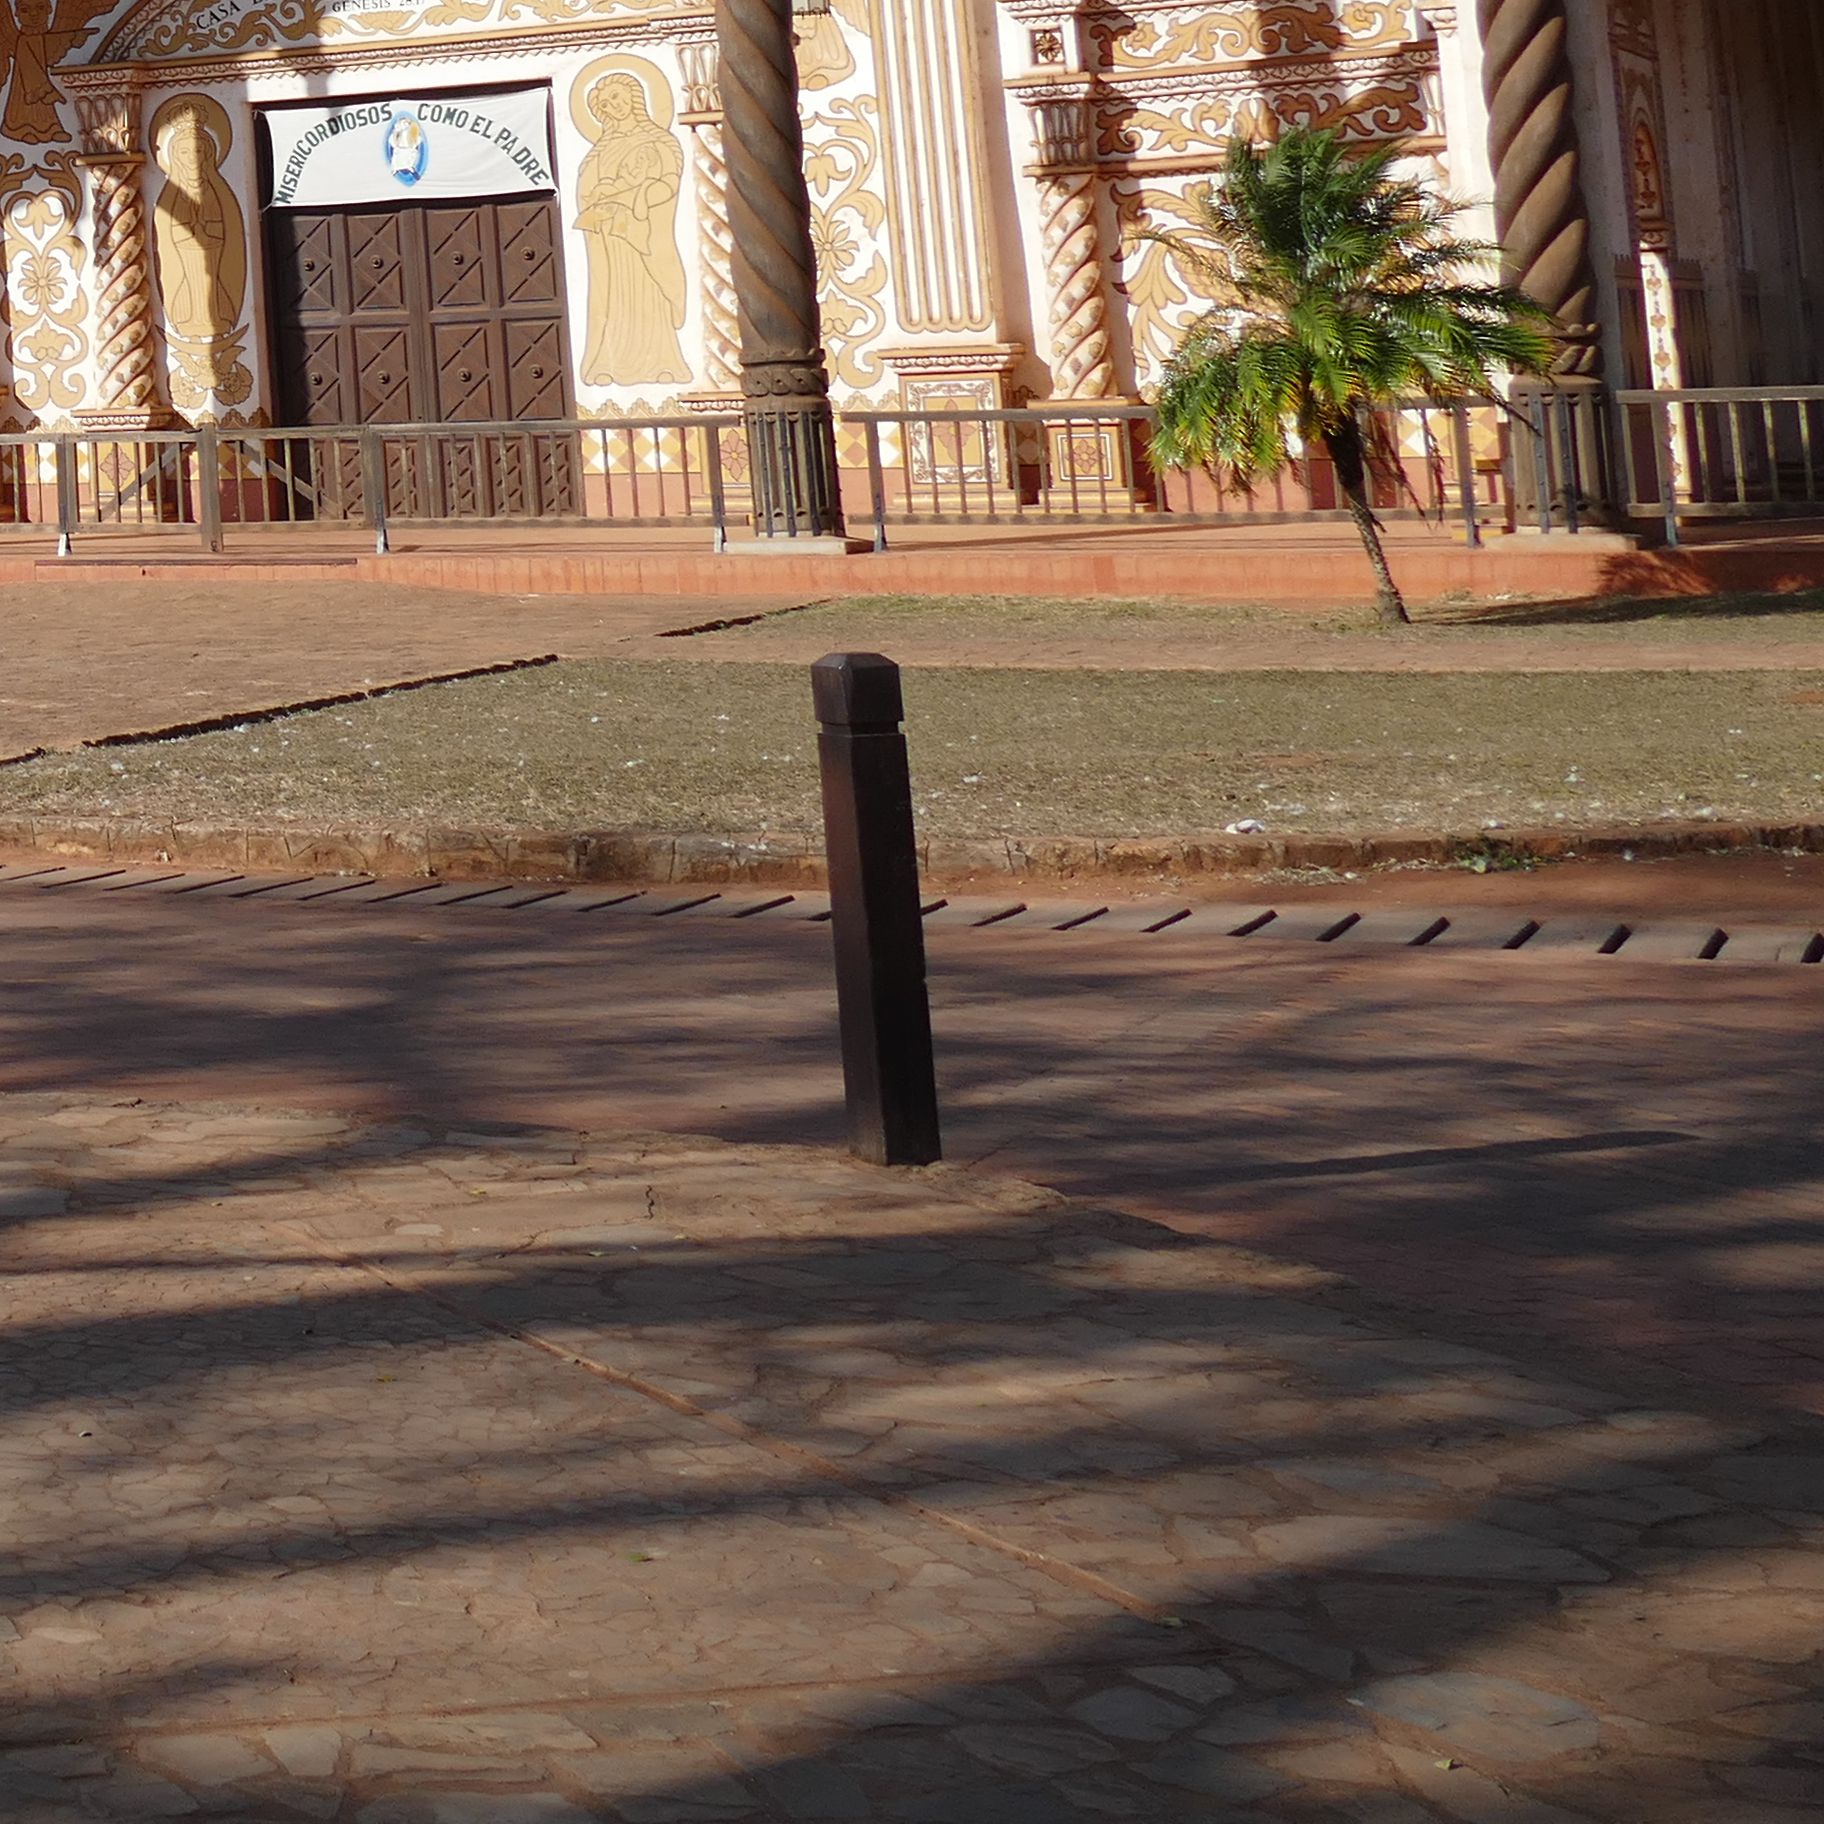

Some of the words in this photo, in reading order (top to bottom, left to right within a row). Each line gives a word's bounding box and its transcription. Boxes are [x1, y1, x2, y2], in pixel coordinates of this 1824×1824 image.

[196, 0, 241, 30] CASA
[273, 102, 393, 204] MISERICORDIOSOS
[417, 102, 468, 129] COMO
[470, 116, 492, 139] EL
[494, 127, 550, 186] PADRE
